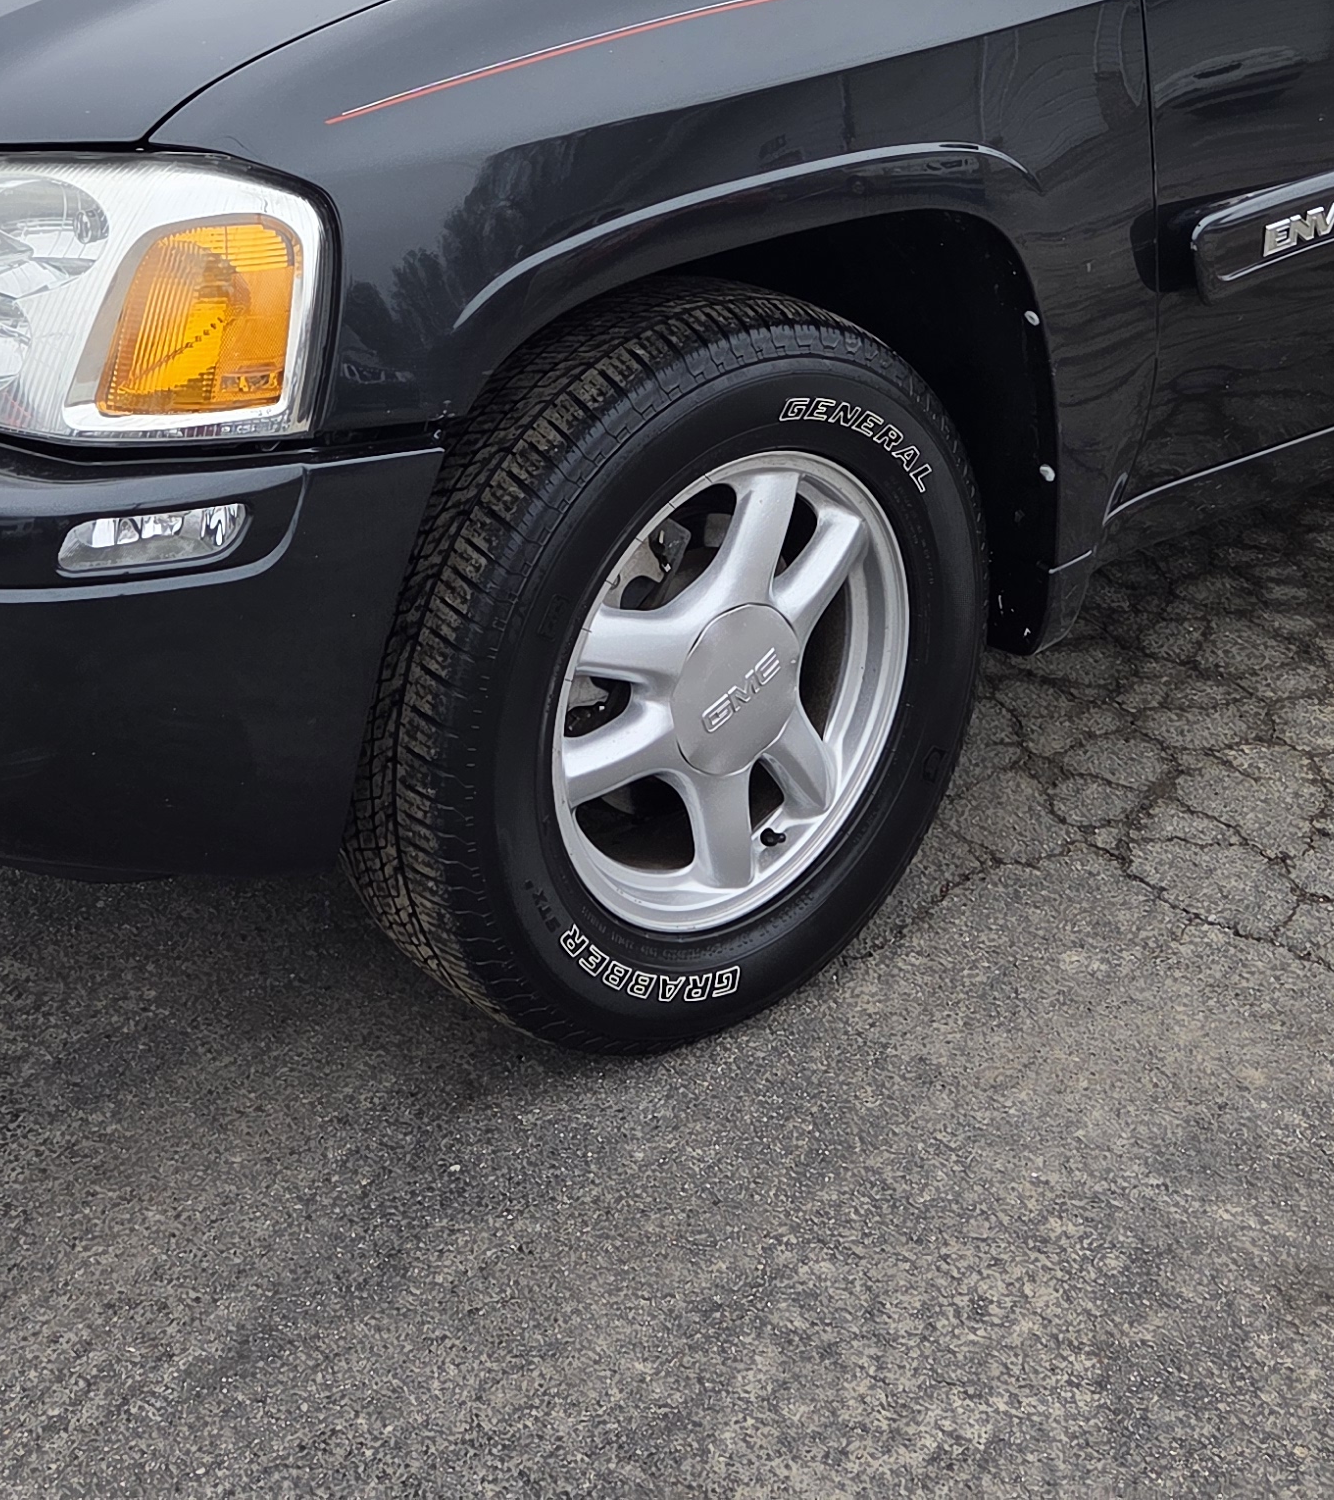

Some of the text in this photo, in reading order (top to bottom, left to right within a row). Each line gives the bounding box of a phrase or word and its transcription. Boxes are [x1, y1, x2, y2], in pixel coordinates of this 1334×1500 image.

[778, 397, 932, 493] GENERAL
[701, 647, 782, 734] GMC
[559, 923, 741, 1002] GRABBER
